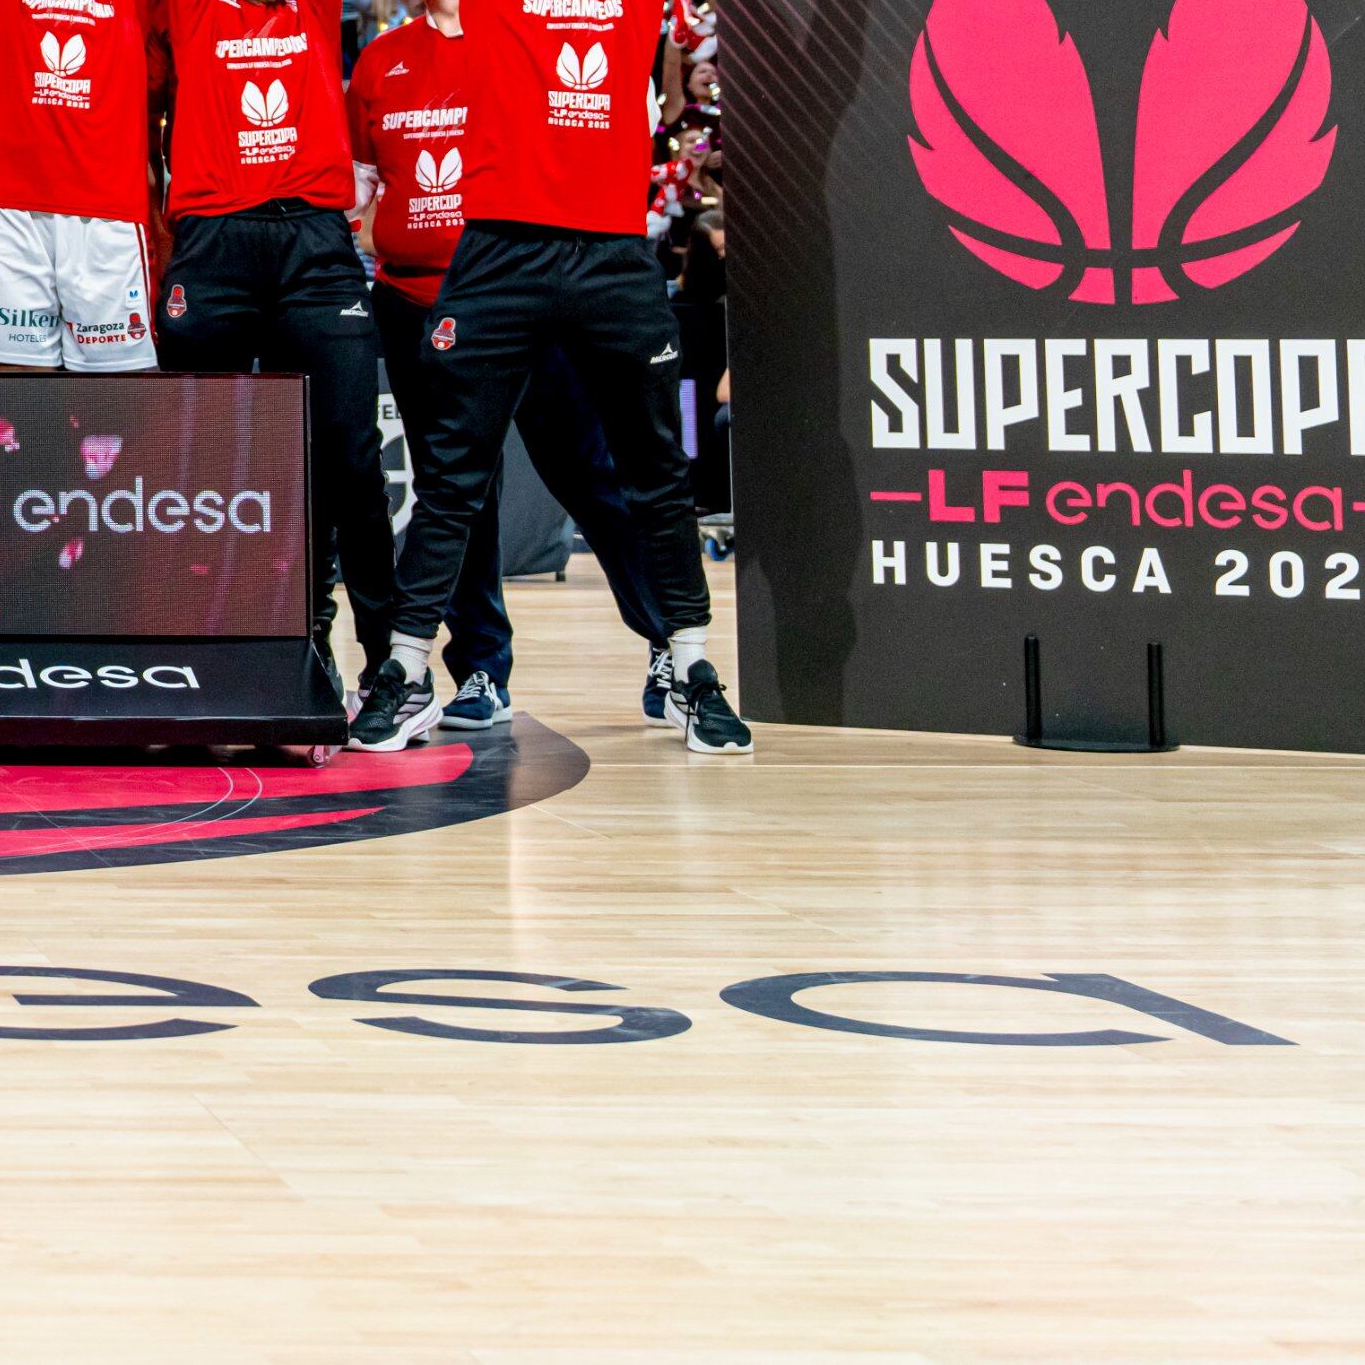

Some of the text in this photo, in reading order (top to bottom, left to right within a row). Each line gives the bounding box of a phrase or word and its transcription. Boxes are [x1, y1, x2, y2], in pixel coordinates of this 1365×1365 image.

[34, 72, 91, 93] SUPERCOPA
[548, 91, 611, 111] SUPERCOPA
[568, 110, 604, 120] endesa
[238, 127, 298, 147] SUPERCOPA
[409, 194, 463, 213] SUPERCOP
[9, 333, 47, 343] HOTELES
[76, 322, 125, 334] Zaragoza
[77, 334, 126, 345] DEPORTE
[13, 477, 271, 533] endesa
[928, 469, 1343, 531] LF endesa
[872, 540, 1172, 594] HUESCA
